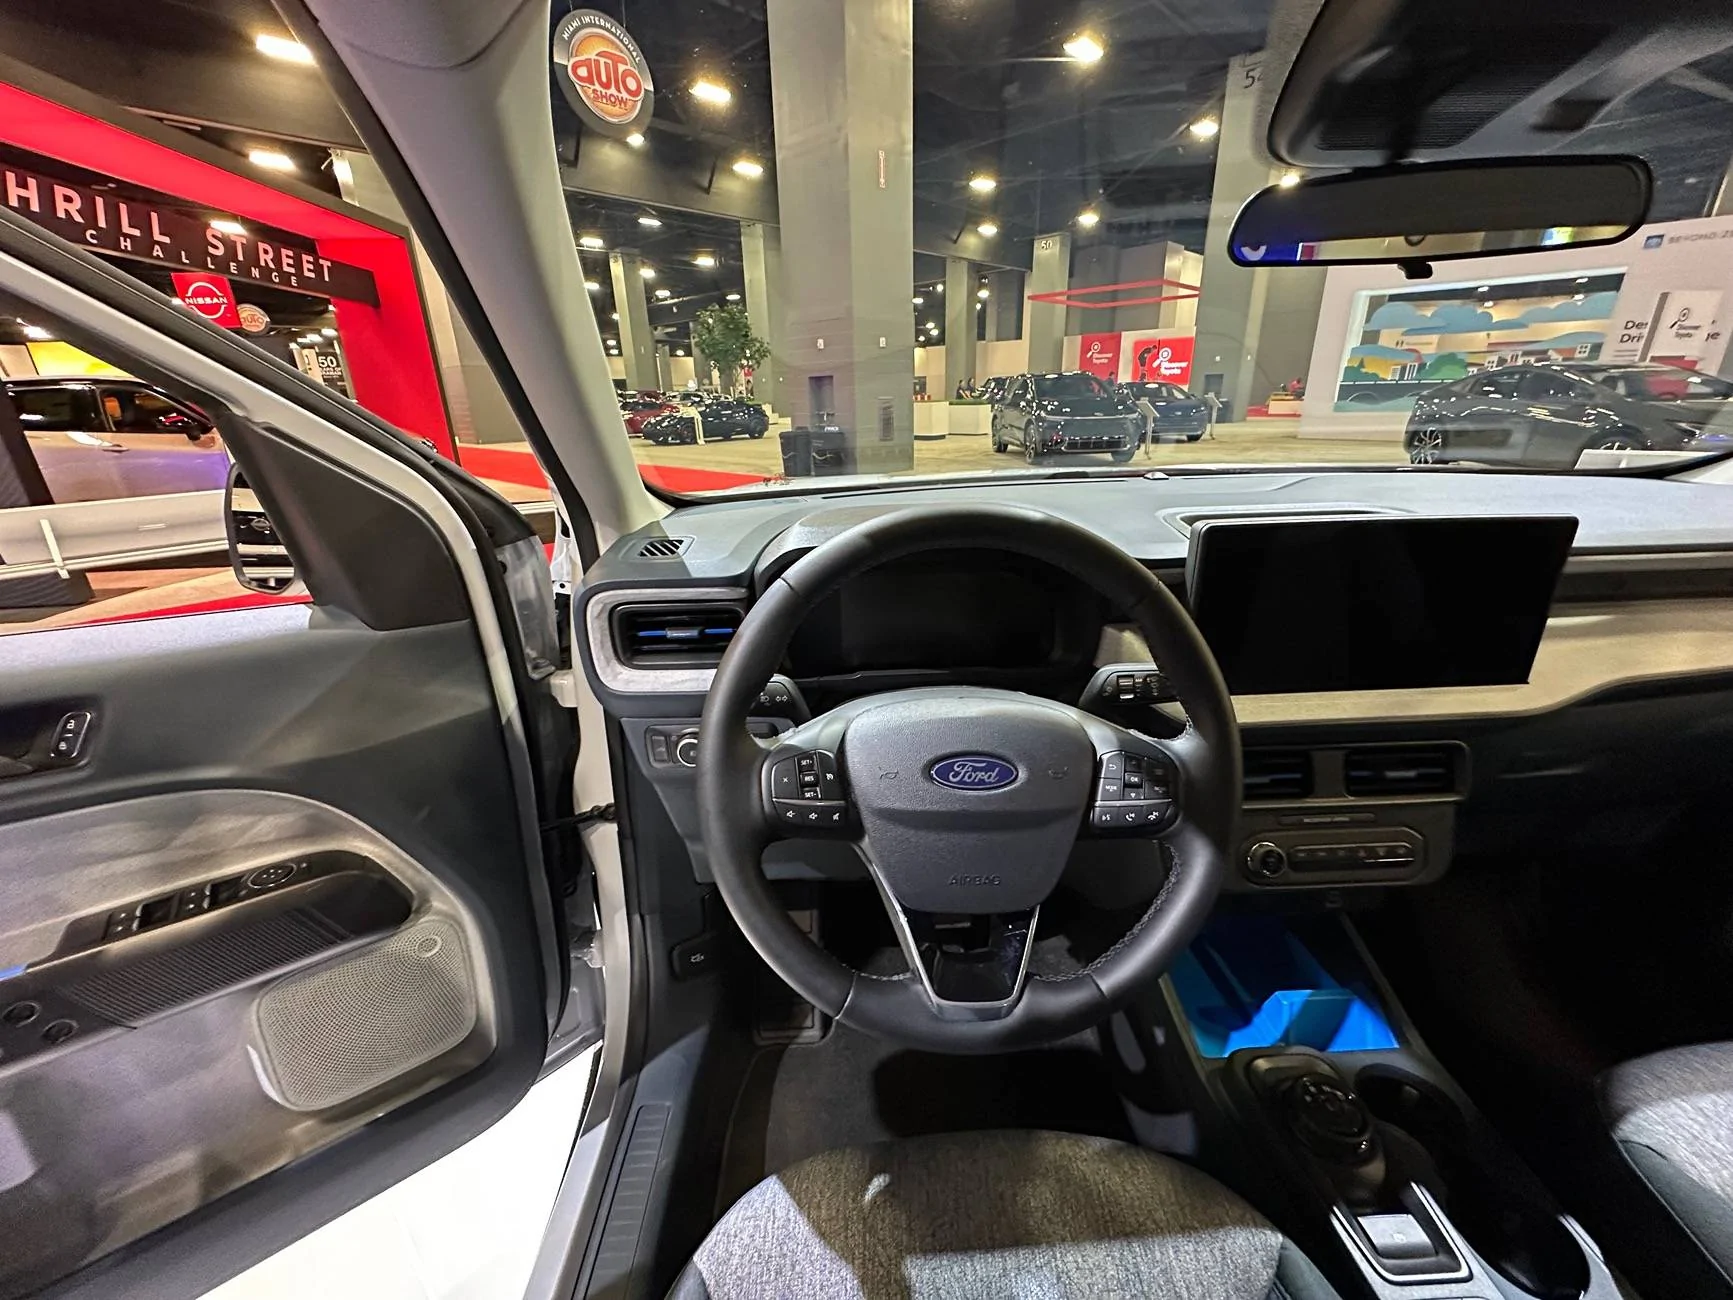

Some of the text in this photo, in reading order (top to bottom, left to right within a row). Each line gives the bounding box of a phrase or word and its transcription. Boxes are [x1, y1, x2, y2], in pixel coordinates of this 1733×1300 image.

[561, 15, 641, 64] MIAMI INTERNATIONAL
[592, 88, 628, 108] SHOW
[1041, 239, 1053, 249] 50
[85, 229, 298, 287] CHALLENGE
[206, 227, 333, 282] STREET
[185, 296, 228, 305] NISSAN
[318, 355, 337, 368] 50
[948, 761, 1000, 783] Ford
[949, 874, 1001, 886] AIRBAG
